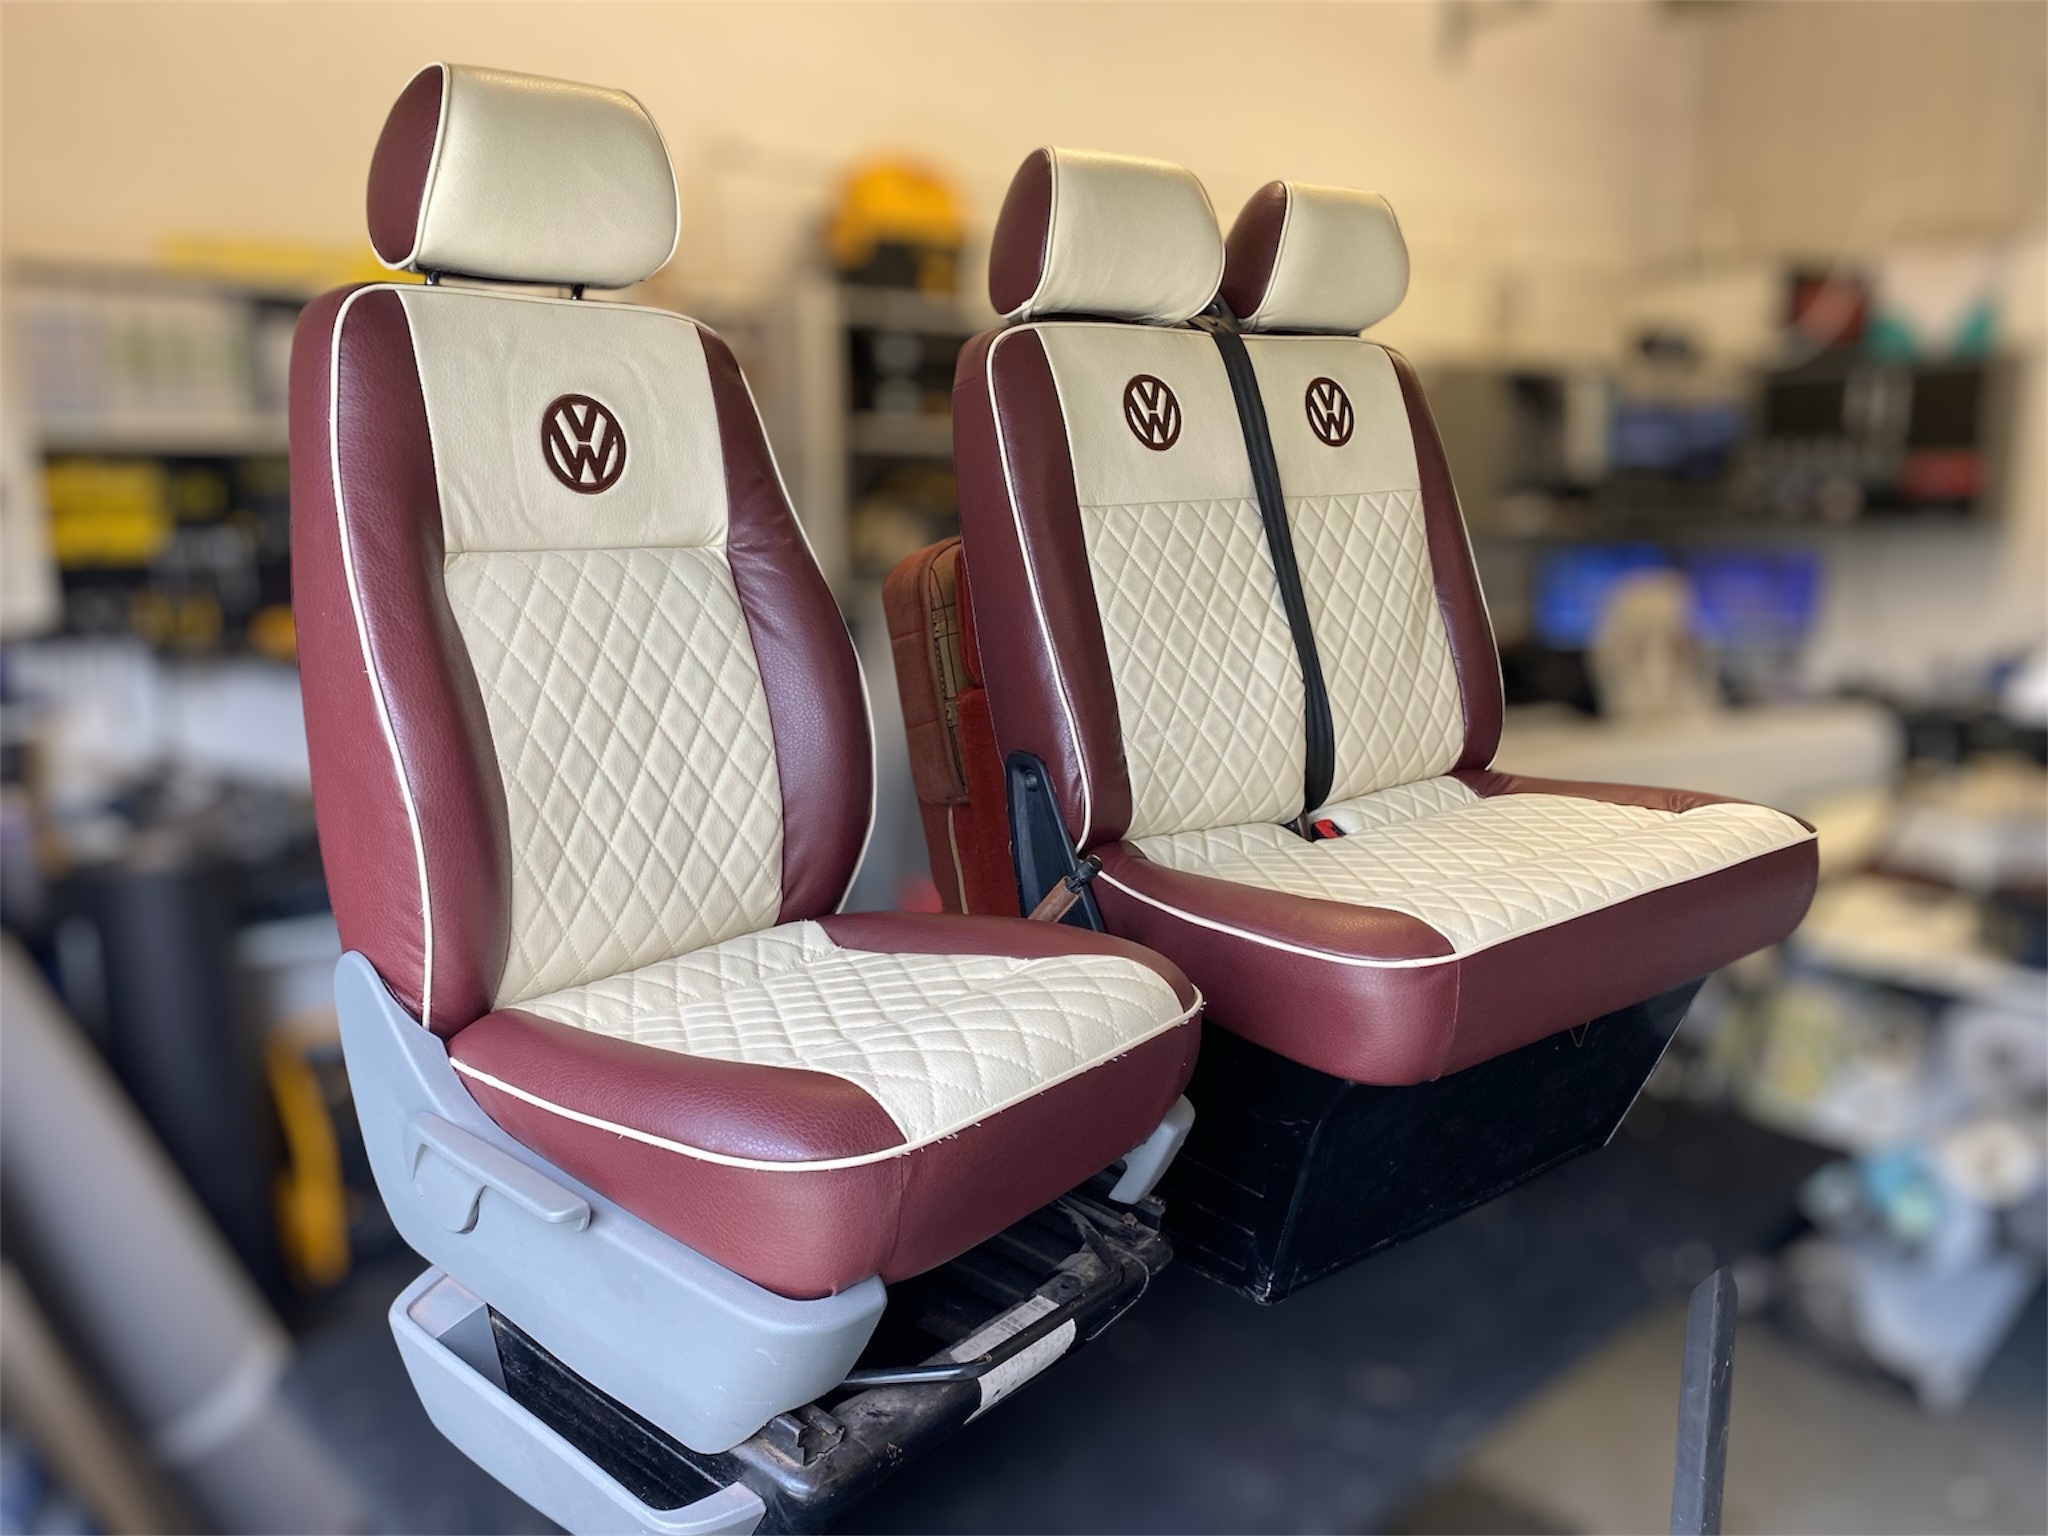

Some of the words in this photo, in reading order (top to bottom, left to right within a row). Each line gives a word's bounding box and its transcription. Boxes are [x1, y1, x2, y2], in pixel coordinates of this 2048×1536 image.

[543, 396, 624, 492] VW
[1124, 376, 1180, 449] VW
[1307, 379, 1352, 445] VW
